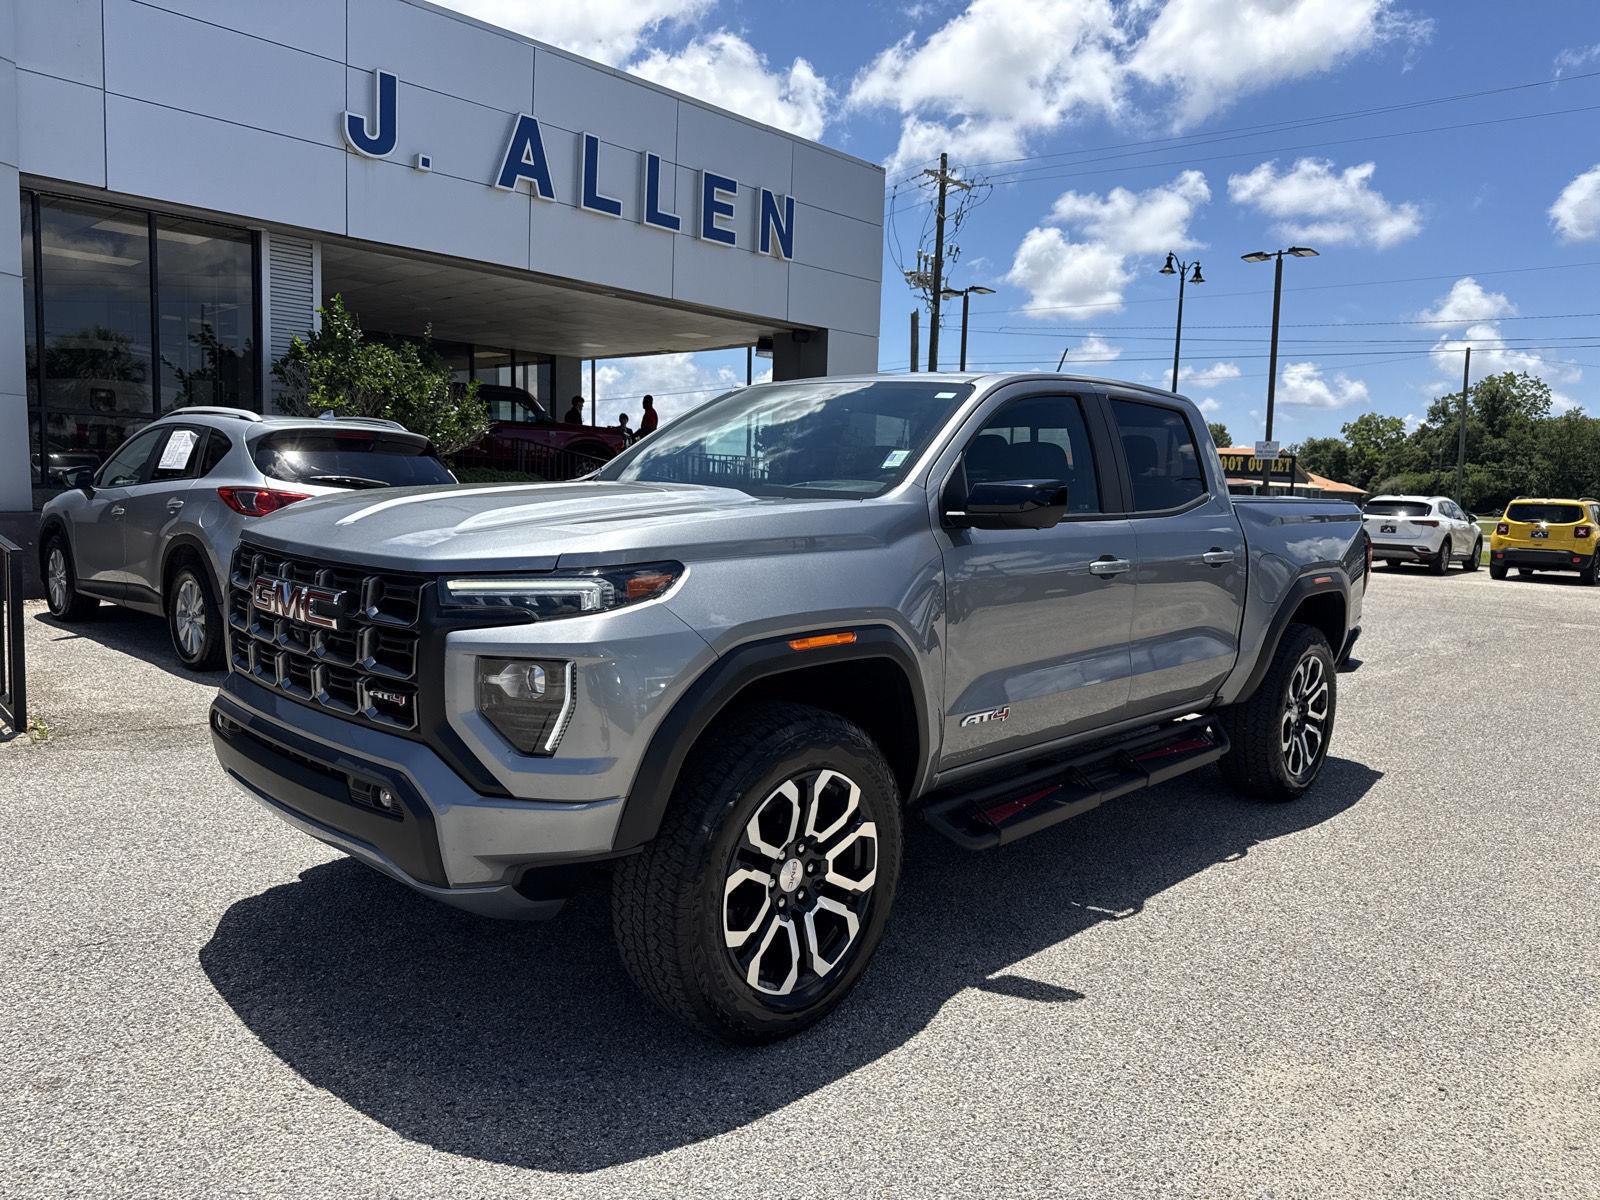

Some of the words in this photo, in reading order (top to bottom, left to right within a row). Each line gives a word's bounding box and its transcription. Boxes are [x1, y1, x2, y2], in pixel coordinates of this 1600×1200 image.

[341, 68, 432, 172] J.
[494, 112, 796, 261] ALLEN
[1220, 456, 1243, 471] OOT
[1248, 457, 1292, 472] OULET
[254, 575, 347, 630] GMC
[369, 690, 405, 706] AT4
[961, 707, 1010, 727] AT4
[788, 861, 798, 889] GMC
